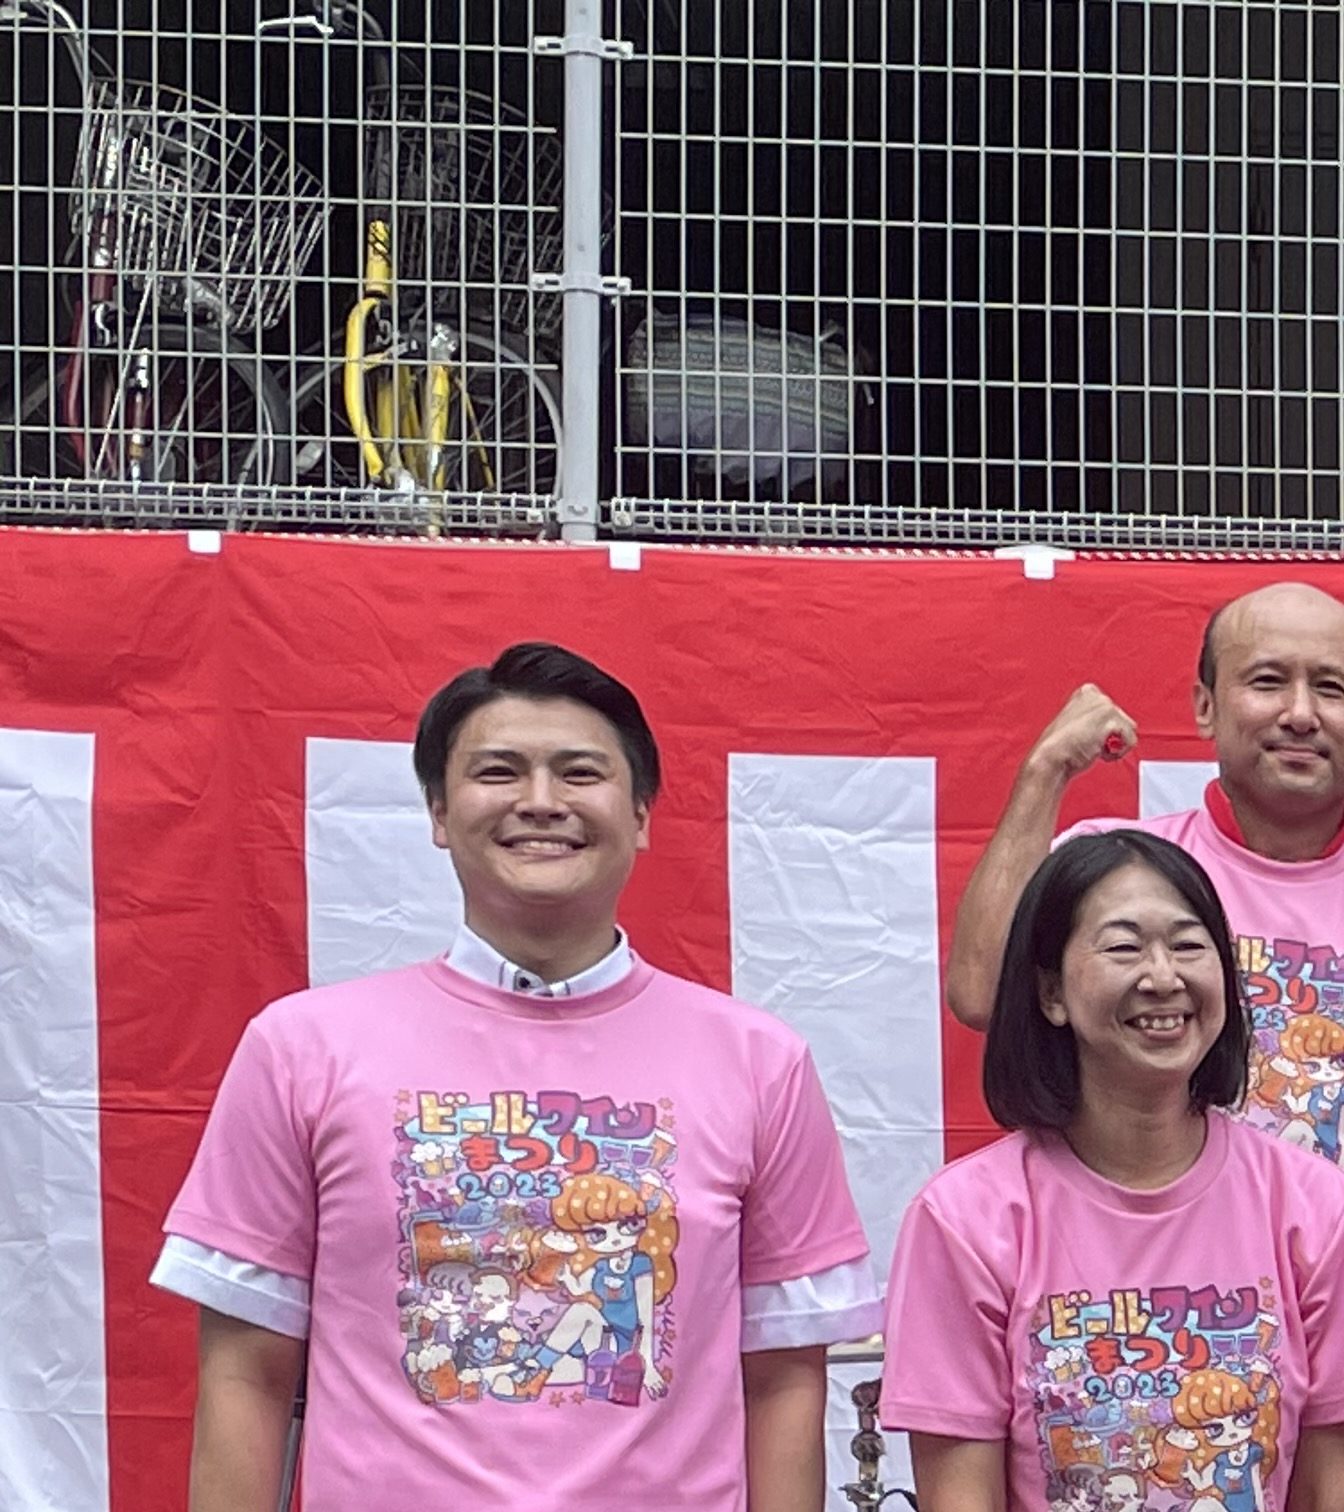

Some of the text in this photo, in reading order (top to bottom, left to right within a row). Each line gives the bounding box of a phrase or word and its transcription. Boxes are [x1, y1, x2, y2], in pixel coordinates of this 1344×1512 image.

[1246, 975, 1318, 1013] つり
[1252, 1010, 1286, 1030] 23
[416, 1089, 657, 1139] ビールワイン
[459, 1131, 599, 1174] まつり
[457, 1172, 561, 1199] 2023
[1047, 1286, 1258, 1339] ビールワイン
[1085, 1328, 1211, 1373] まつり
[1085, 1372, 1181, 1400] 2023
